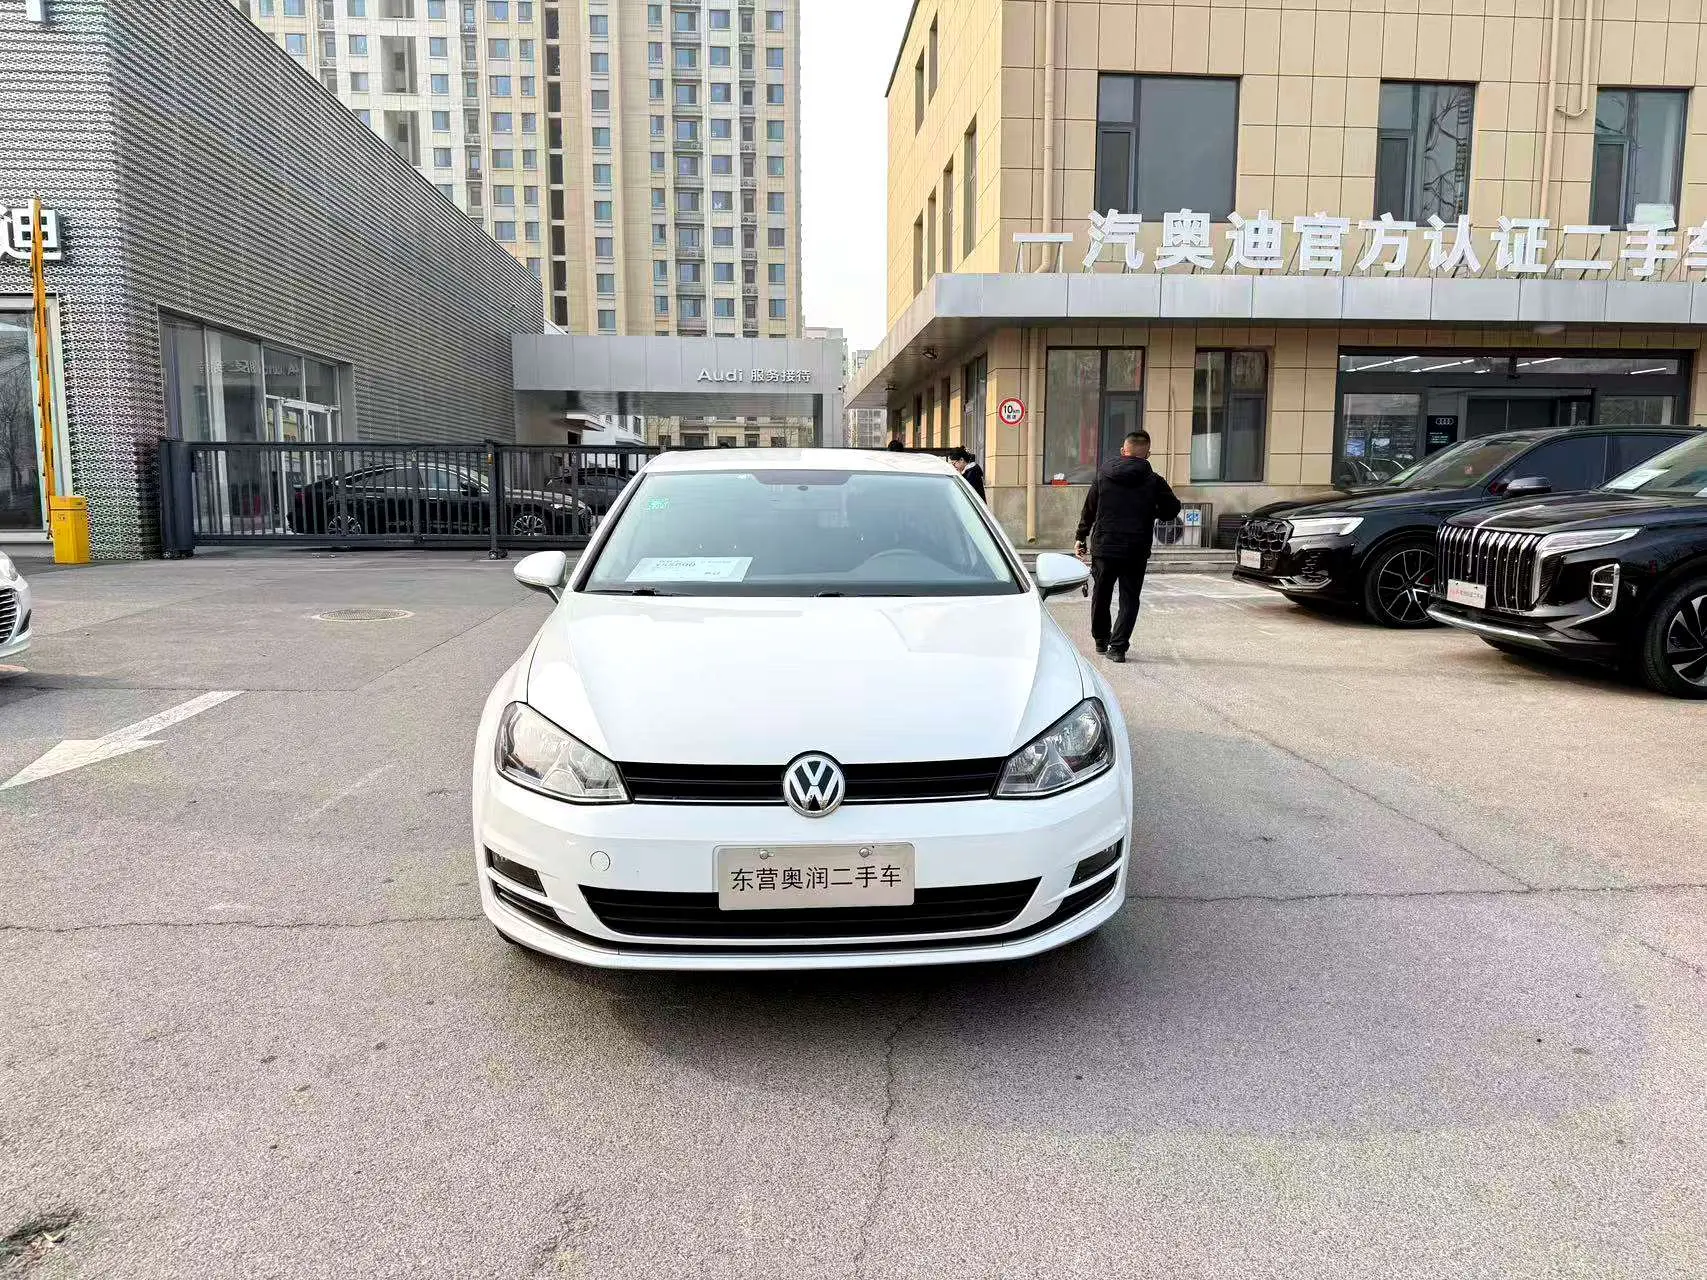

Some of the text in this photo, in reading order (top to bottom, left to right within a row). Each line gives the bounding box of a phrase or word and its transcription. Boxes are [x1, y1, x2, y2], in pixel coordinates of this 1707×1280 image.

[697, 368, 811, 383] Audi 服务接待
[730, 864, 902, 892] 东营奥润二手车
